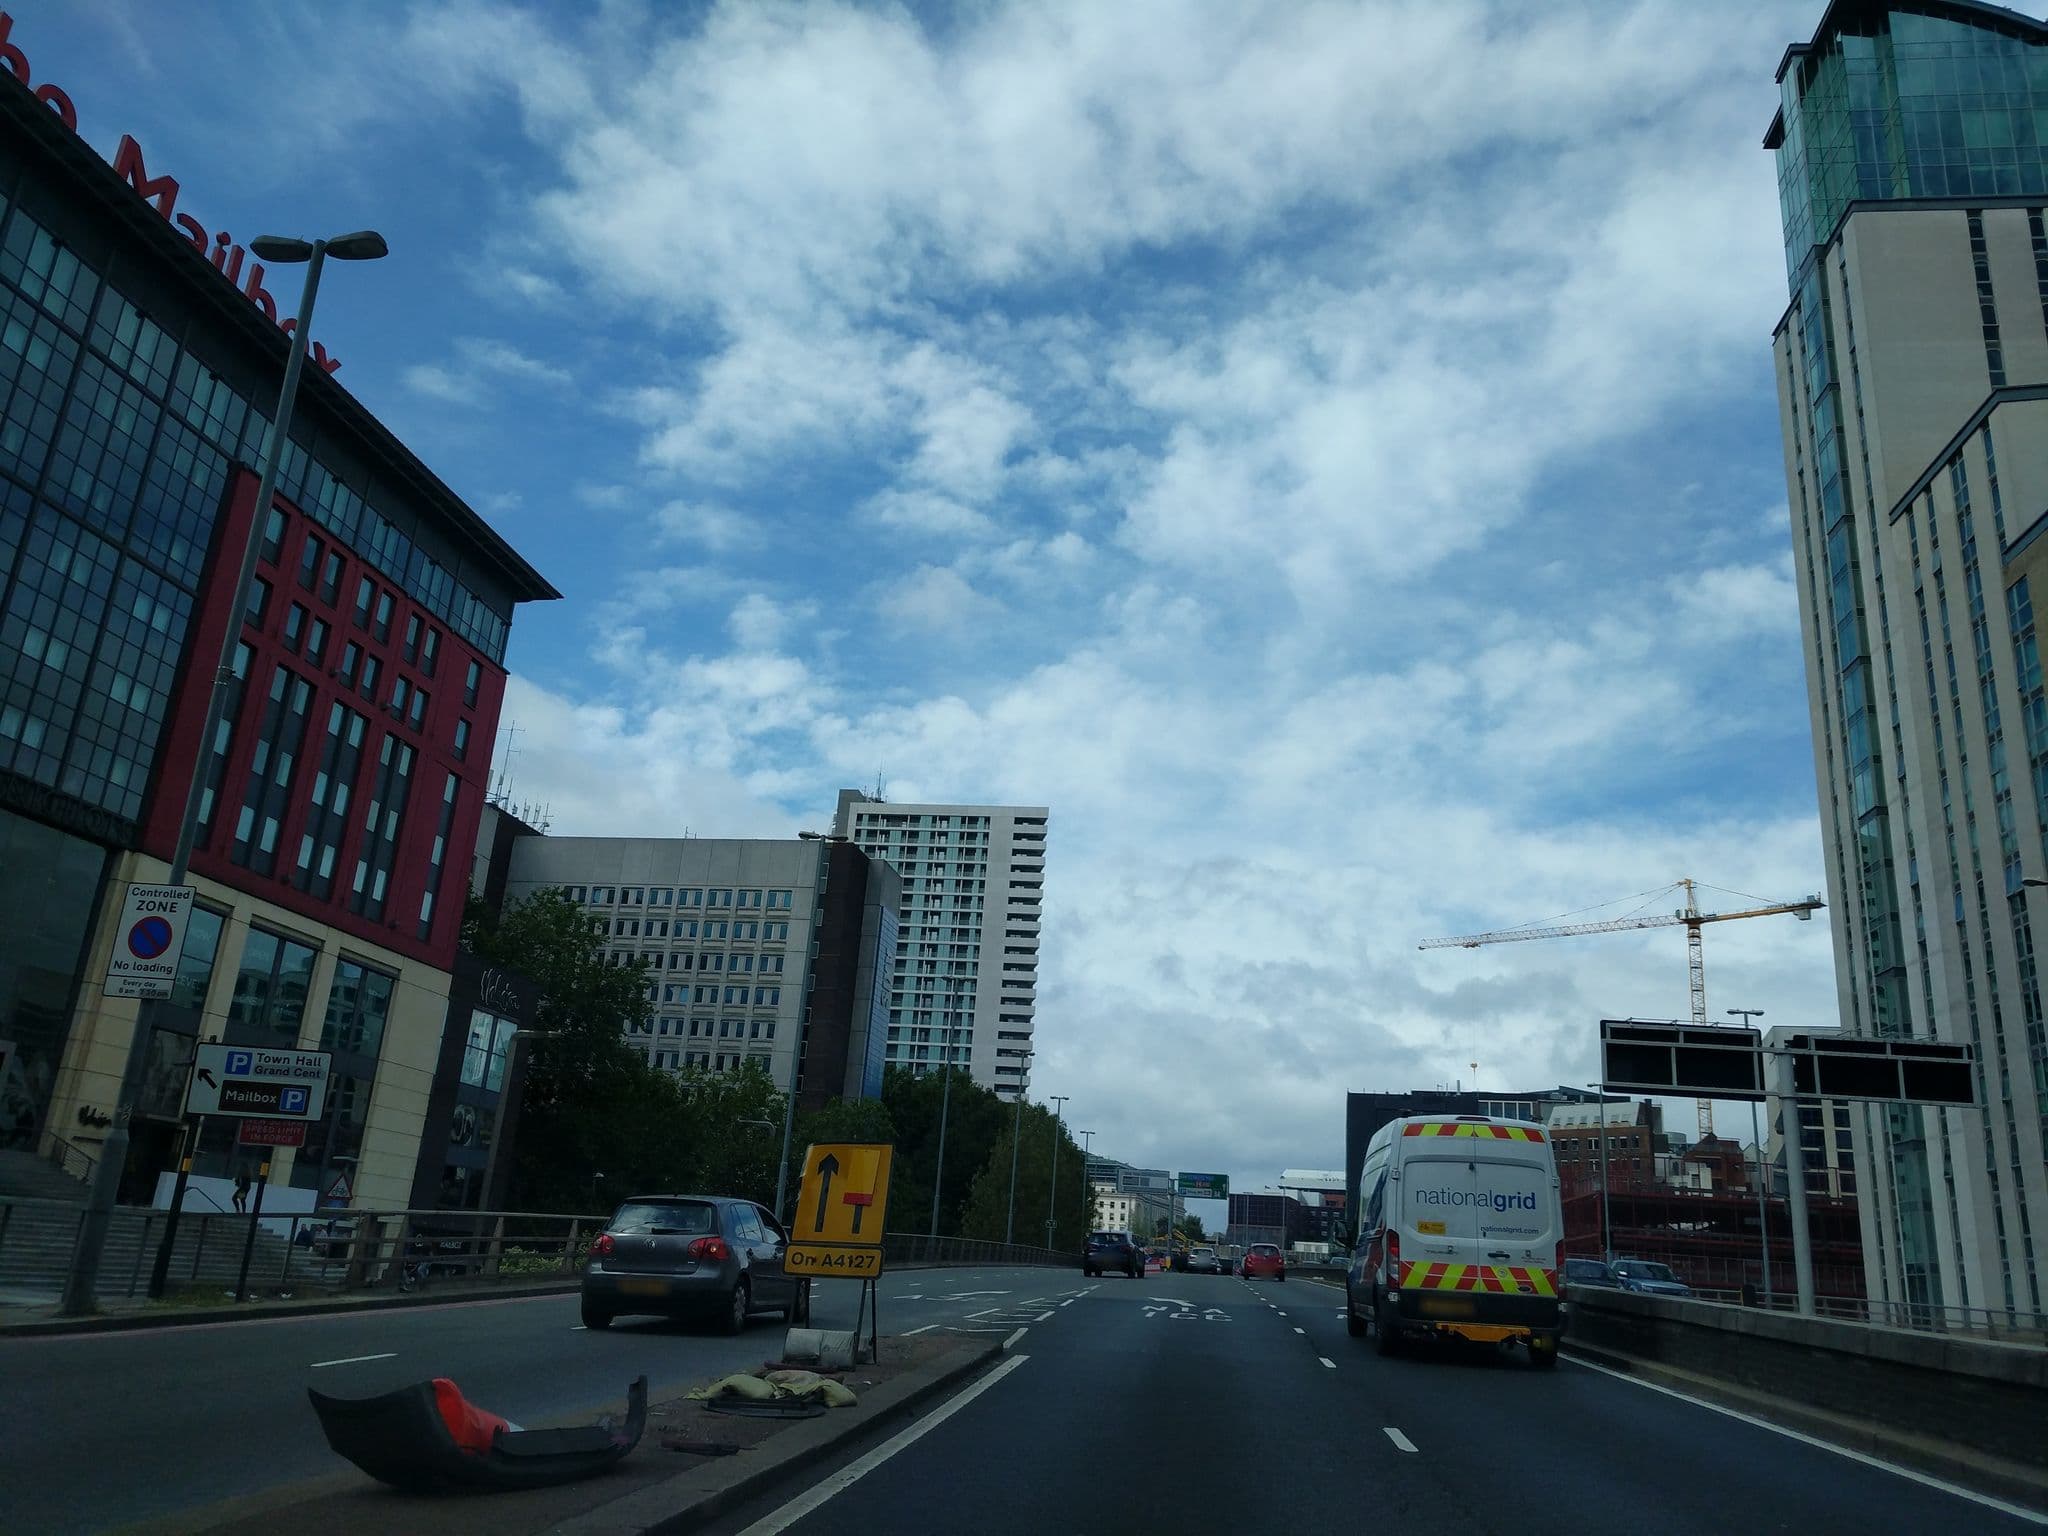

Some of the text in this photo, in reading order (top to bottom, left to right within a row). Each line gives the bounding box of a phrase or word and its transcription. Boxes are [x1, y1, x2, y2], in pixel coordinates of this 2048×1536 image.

[131, 886, 191, 900] Controlled
[136, 900, 178, 913] ZONE
[113, 960, 174, 975] No loading
[122, 979, 157, 989] Every day
[256, 1052, 290, 1065] Town
[295, 1055, 322, 1067] Hall
[254, 1065, 321, 1078] Grand Cent
[225, 1090, 278, 1104] Mailbox
[278, 1126, 302, 1136] LIMIT
[1416, 1188, 1536, 1212] nationalgrid
[1480, 1225, 1540, 1235] nationalgrid.com
[791, 1251, 876, 1268] On A4127
